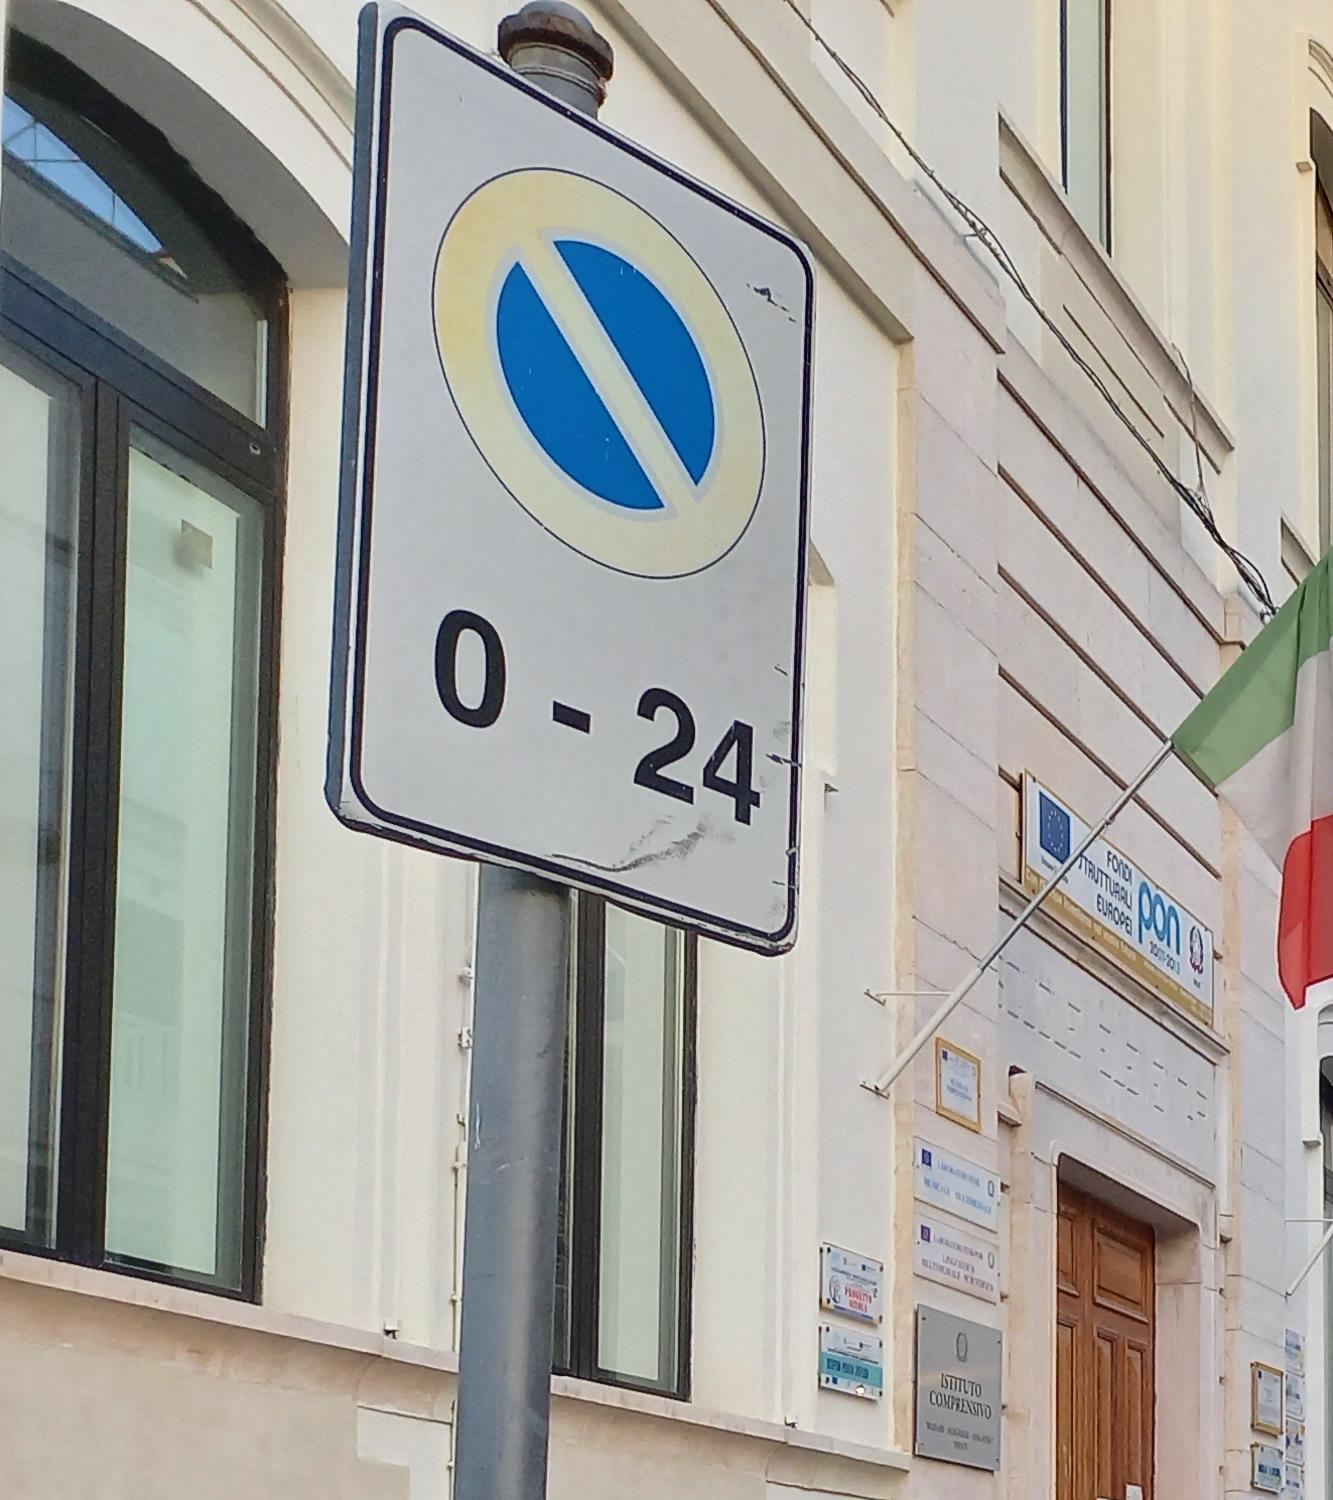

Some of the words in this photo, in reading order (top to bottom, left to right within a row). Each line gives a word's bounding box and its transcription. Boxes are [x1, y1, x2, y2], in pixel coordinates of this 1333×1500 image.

[435, 608, 507, 730] 0
[632, 686, 761, 827] 24
[1106, 850, 1133, 886] FONDI
[1096, 893, 1133, 937] EUROPEI
[1138, 880, 1181, 957] pon
[929, 1390, 993, 1420] COMPRENSIVO
[940, 1372, 983, 1398] ISTITUTO
